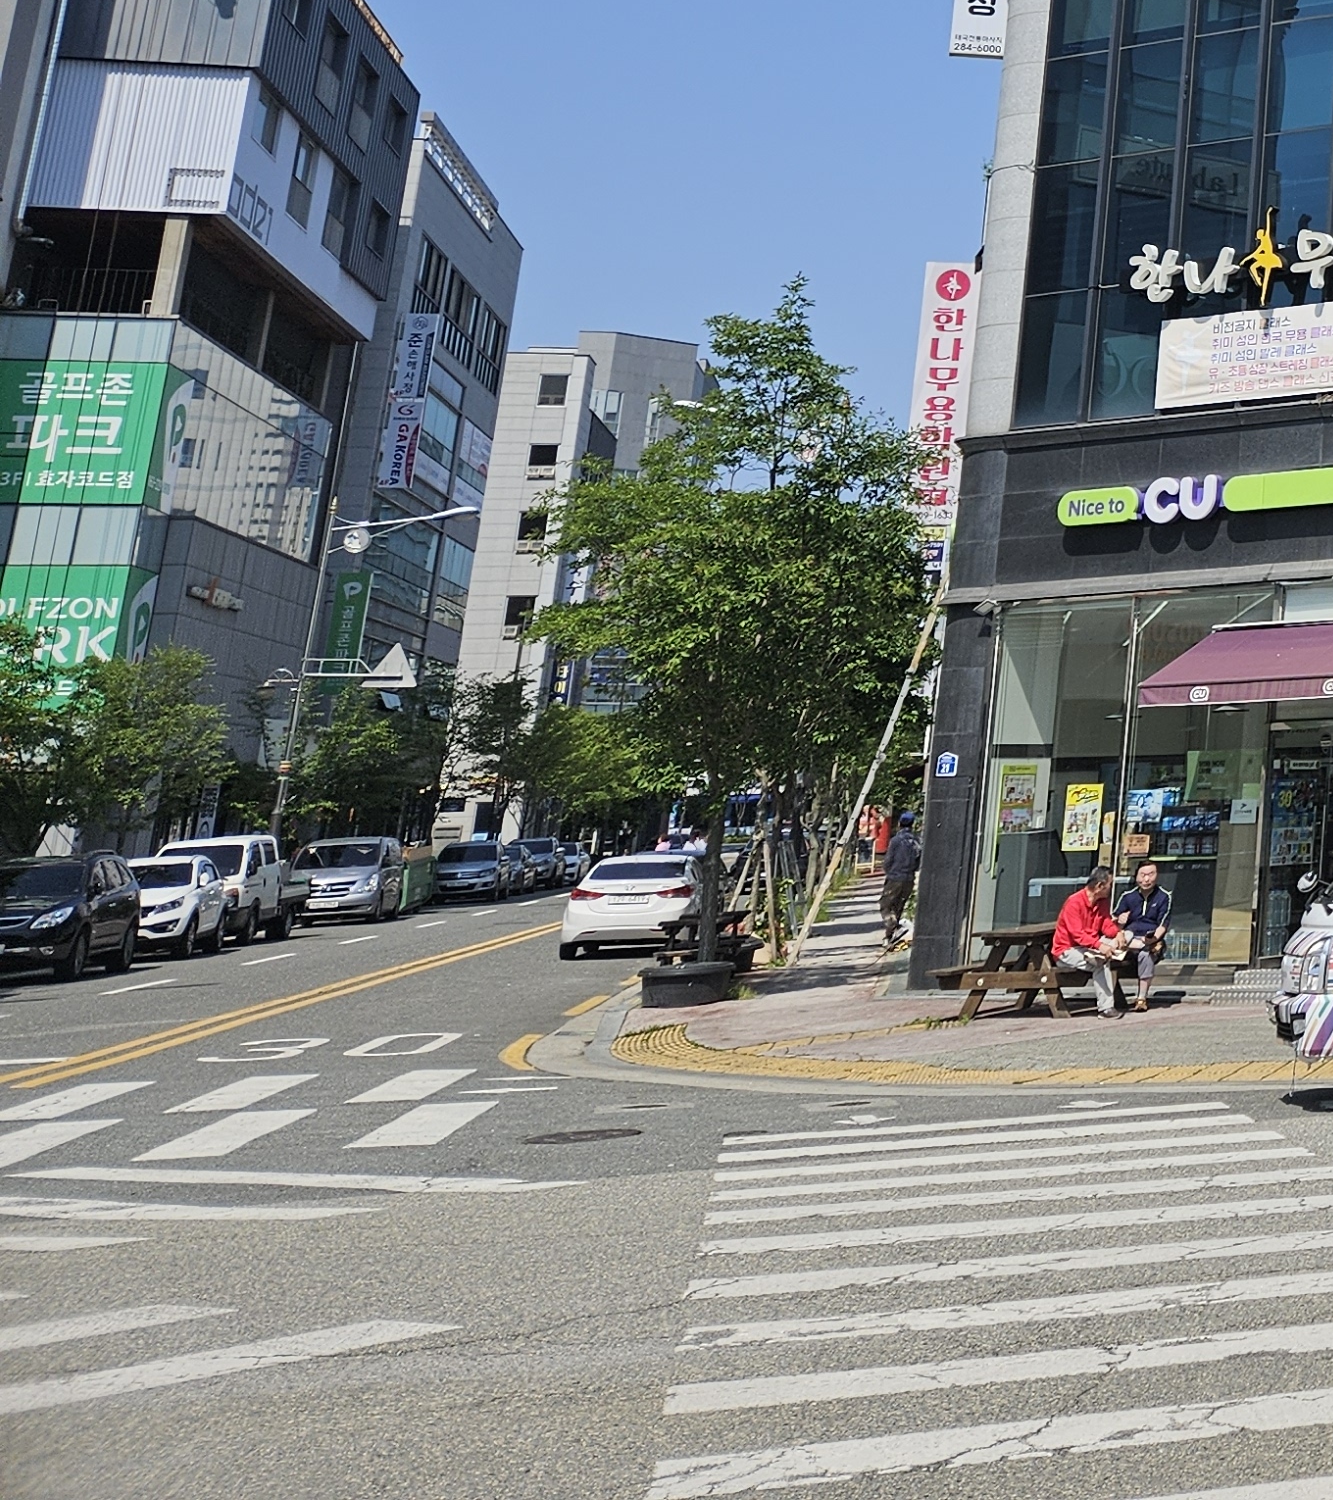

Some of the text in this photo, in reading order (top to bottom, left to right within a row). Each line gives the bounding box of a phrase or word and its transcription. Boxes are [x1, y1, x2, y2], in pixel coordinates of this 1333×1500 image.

[954, 43, 1002, 53] 284-6000
[1129, 243, 1243, 303] 한나
[1213, 318, 1256, 334] 비전공자
[1212, 336, 1233, 350] 취미
[1236, 333, 1258, 347] 성인
[1235, 348, 1256, 362] 성인
[19, 372, 134, 406] 골프존
[5, 414, 123, 463] 파크
[35, 470, 135, 489] 효자코드점
[1067, 474, 1221, 524] Nice to CU
